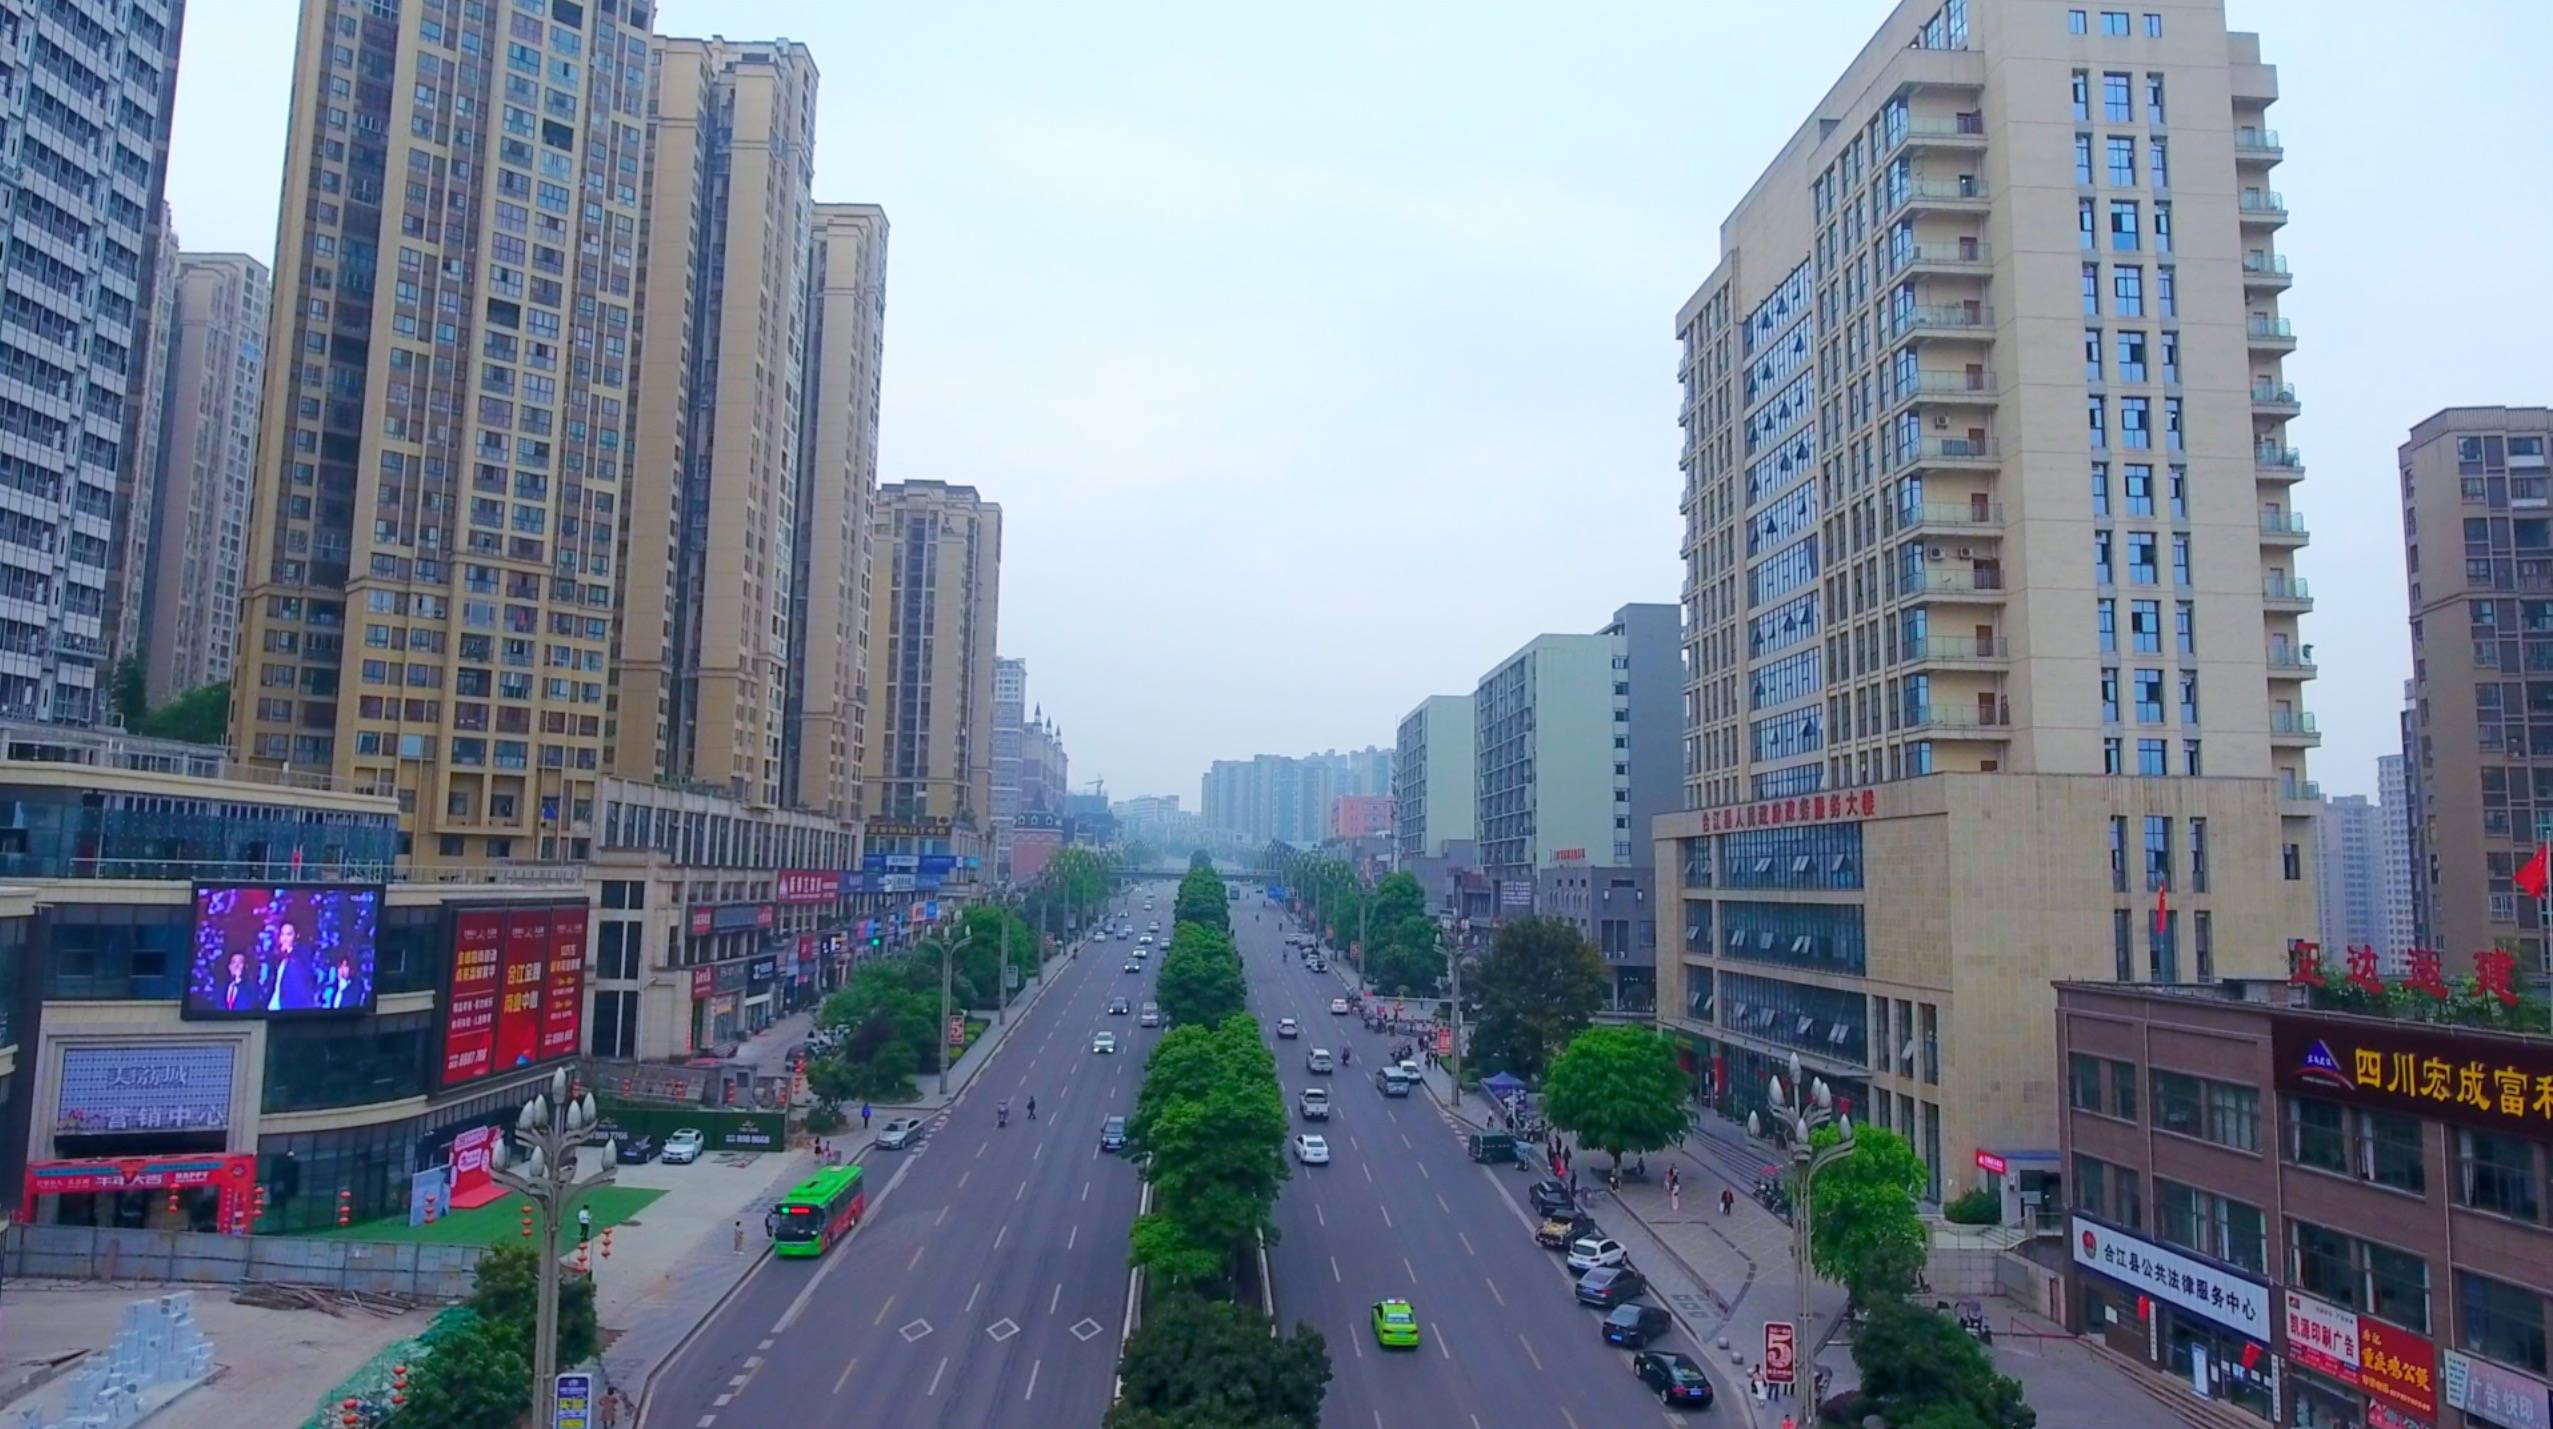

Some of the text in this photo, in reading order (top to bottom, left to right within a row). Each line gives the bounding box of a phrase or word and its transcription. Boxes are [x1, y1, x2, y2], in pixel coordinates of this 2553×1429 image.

[1702, 789, 1875, 833] 合江县人民政府政务服务大楼
[107, 1105, 225, 1129] 营销中心
[2103, 1242, 2257, 1322] 合江县公共法律服务中心
